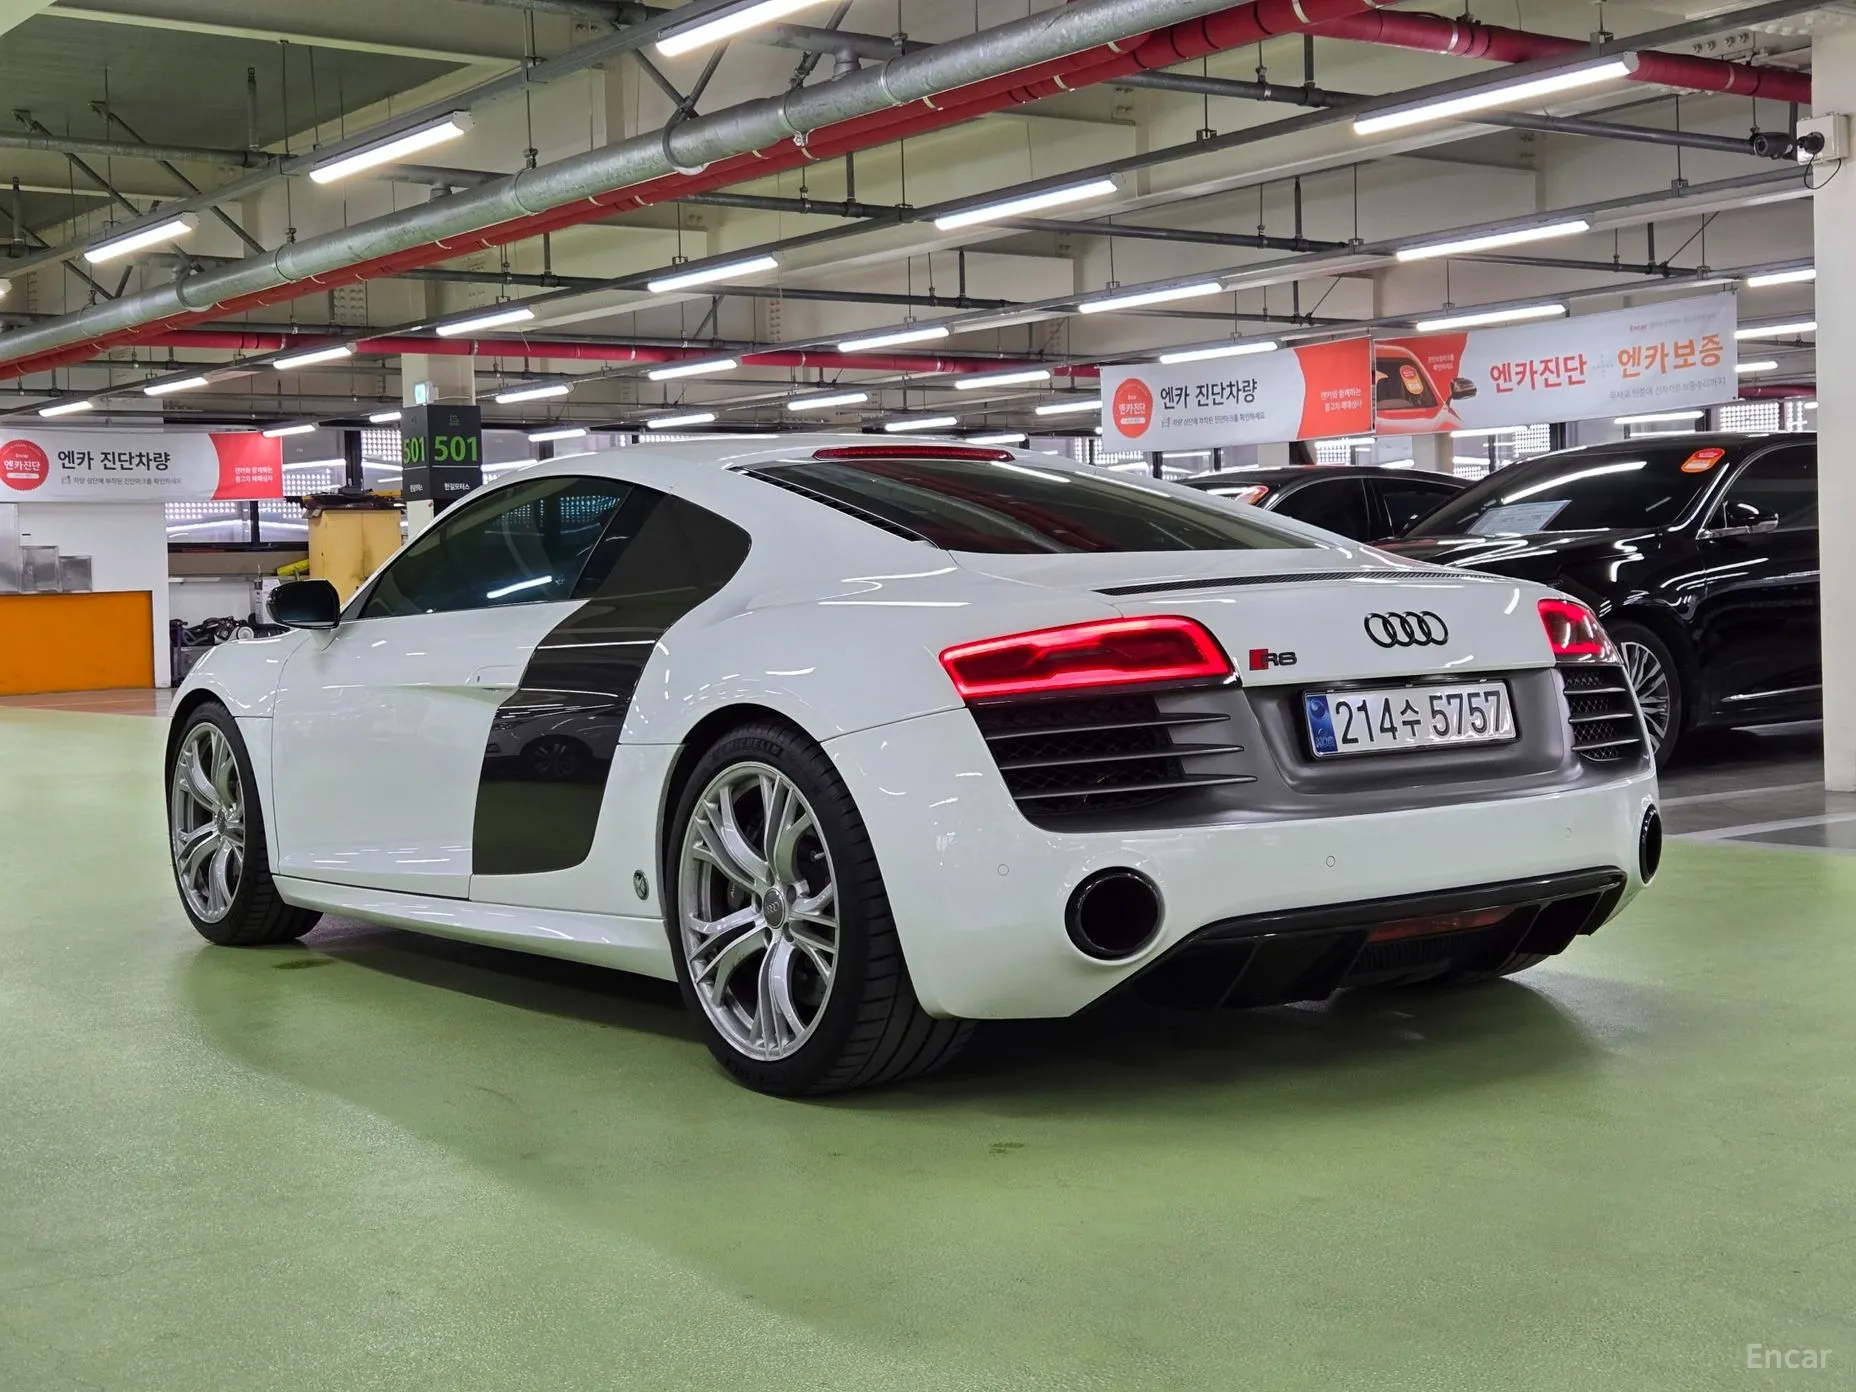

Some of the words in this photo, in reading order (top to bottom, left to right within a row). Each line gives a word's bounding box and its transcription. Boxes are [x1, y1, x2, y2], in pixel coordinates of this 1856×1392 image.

[1489, 353, 1587, 394] 엔카진단
[1617, 333, 1724, 380] 엔카보증
[1160, 385, 1190, 410] 엔카
[1195, 378, 1258, 407] 진단차량
[1118, 402, 1146, 415] 엔카진단
[57, 450, 94, 471] 엔카
[100, 451, 171, 471] 진단차량
[403, 436, 425, 464] 501
[434, 435, 478, 462] 501
[3, 460, 41, 471] 엔카진단
